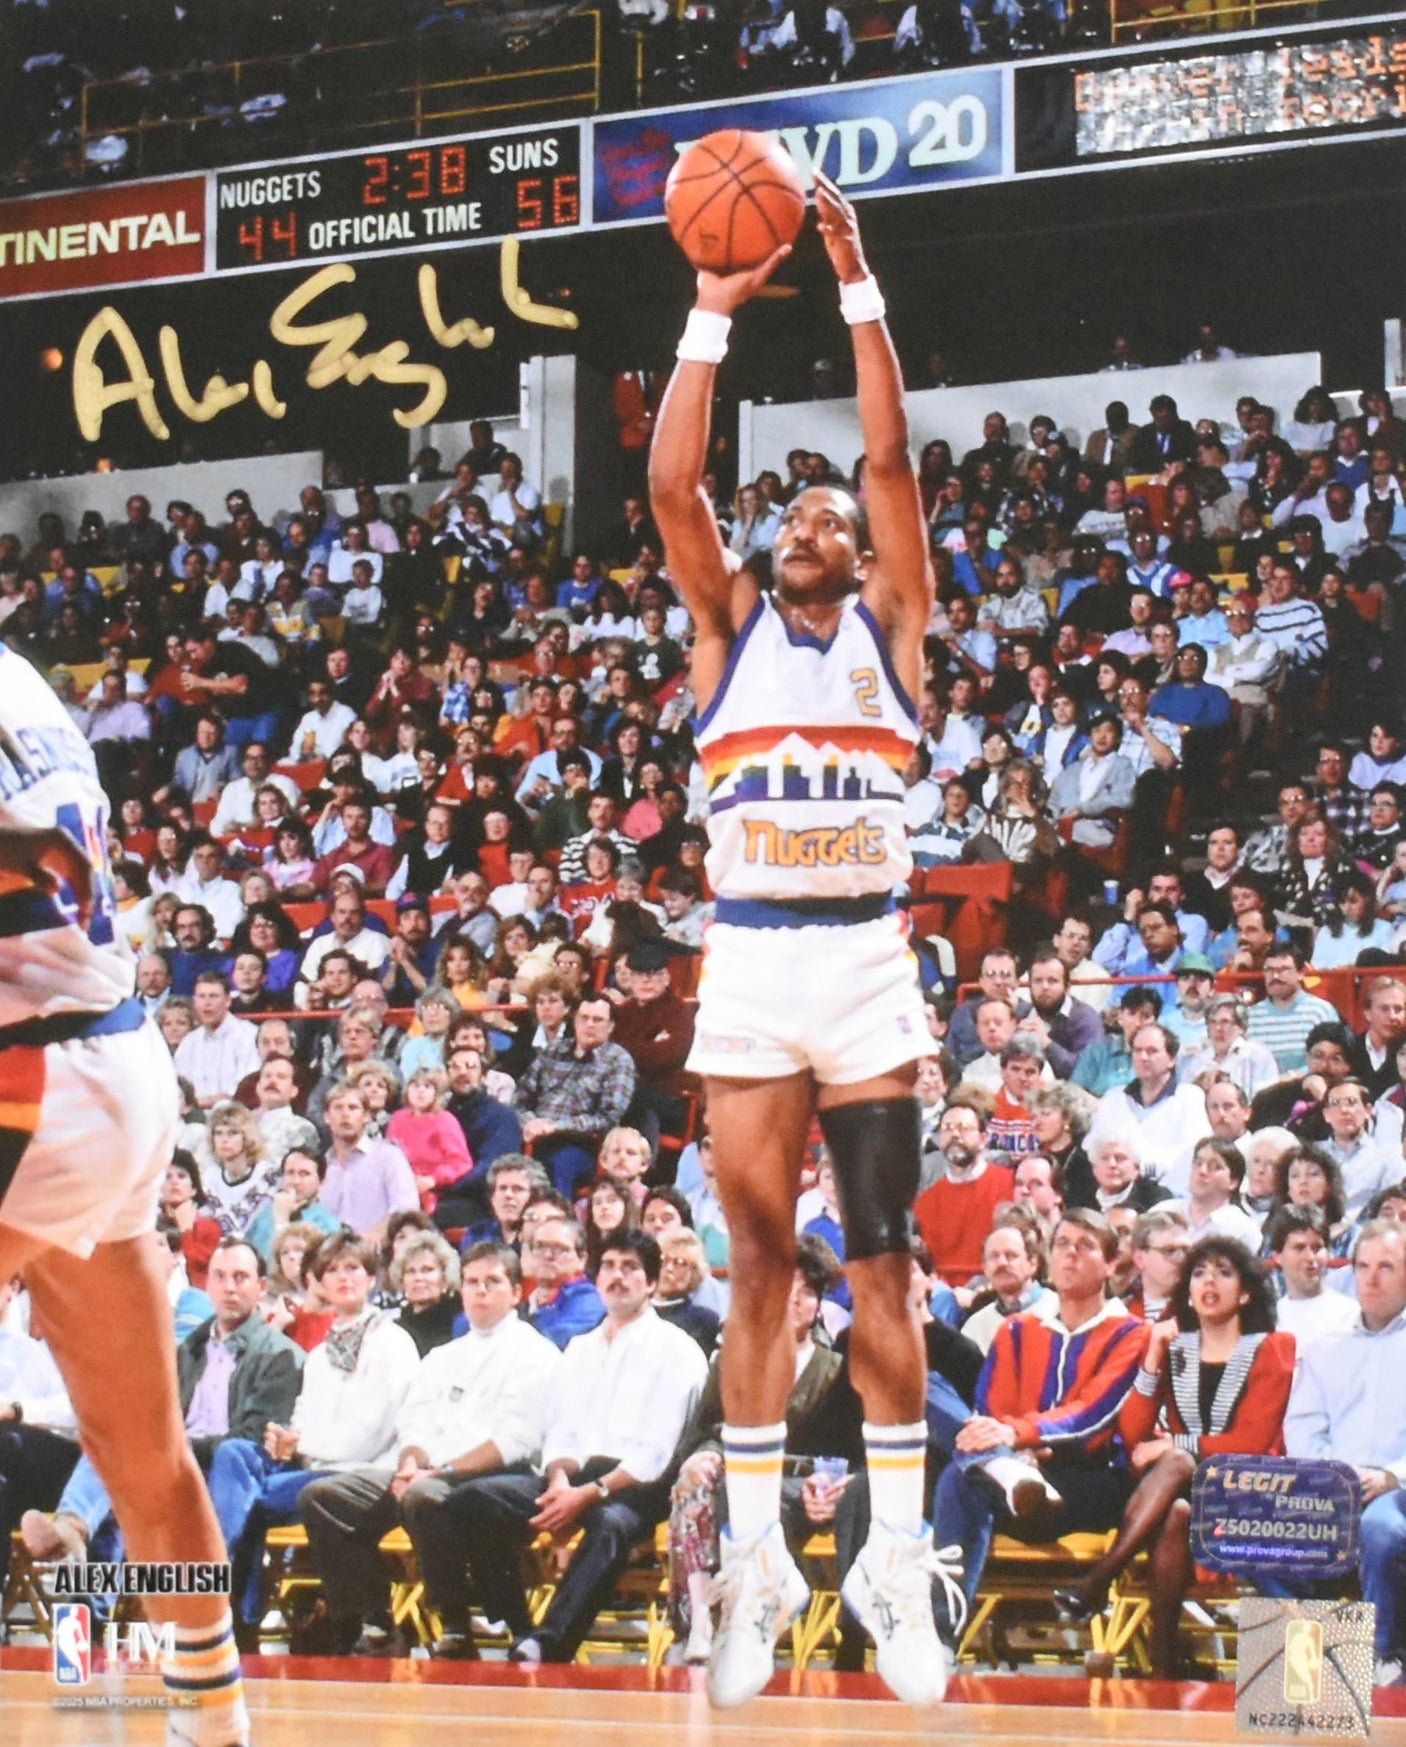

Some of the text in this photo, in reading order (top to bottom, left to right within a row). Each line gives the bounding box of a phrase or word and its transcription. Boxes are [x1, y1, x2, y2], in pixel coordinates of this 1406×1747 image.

[908, 94, 987, 167] 20
[363, 146, 466, 205] 2:38
[489, 139, 559, 174] SUNS
[219, 171, 321, 209] NUGGETS
[516, 174, 578, 230] 56
[239, 212, 296, 261] 44
[308, 202, 482, 250] OFFICIAL TIME
[850, 667, 882, 717] 2
[1223, 1470, 1298, 1493] LEGIT
[1275, 1495, 1335, 1512] PROVA
